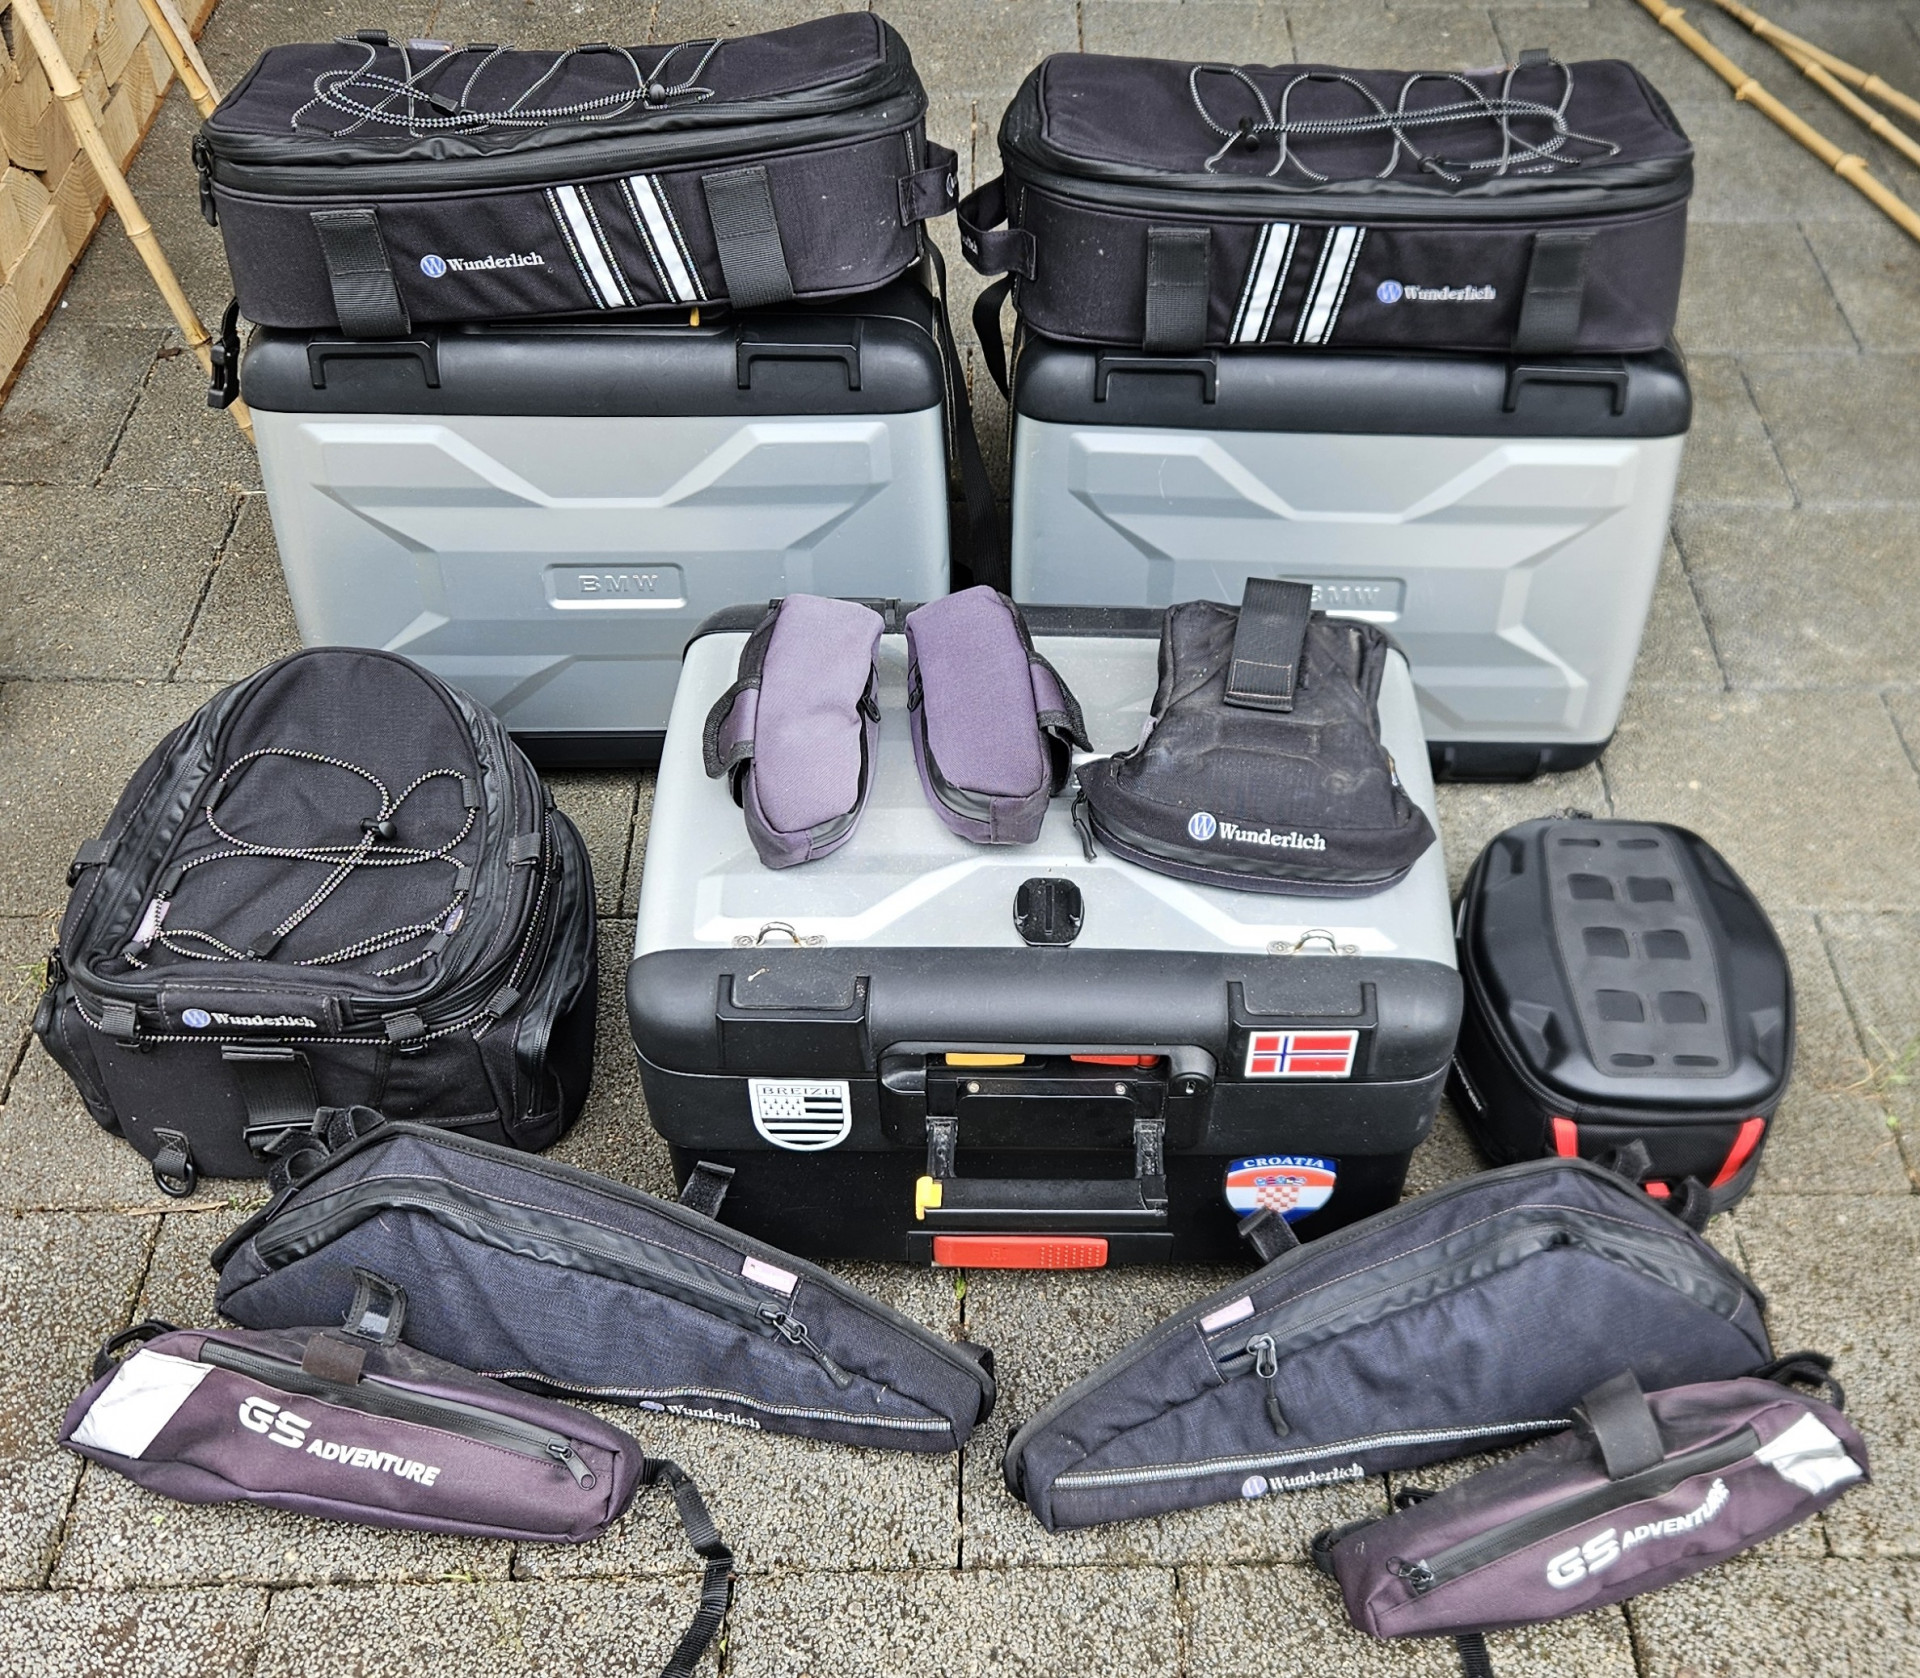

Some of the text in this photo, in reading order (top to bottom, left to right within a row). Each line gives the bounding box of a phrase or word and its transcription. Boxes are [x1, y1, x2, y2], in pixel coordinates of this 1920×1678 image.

[446, 252, 545, 271] Wunderlich
[1404, 284, 1496, 300] Wunderlich
[578, 574, 658, 592] BMW
[1219, 822, 1326, 850] Wunderlich
[211, 1012, 317, 1028] Wunderlich
[762, 1087, 836, 1095] BREIZH
[1243, 1157, 1325, 1169] CROATIA
[666, 1404, 761, 1430] Wunderlich
[238, 1396, 441, 1487] GS ADVENTURE
[1269, 1462, 1365, 1492] Wunderlich
[1547, 1527, 1621, 1589] GS
